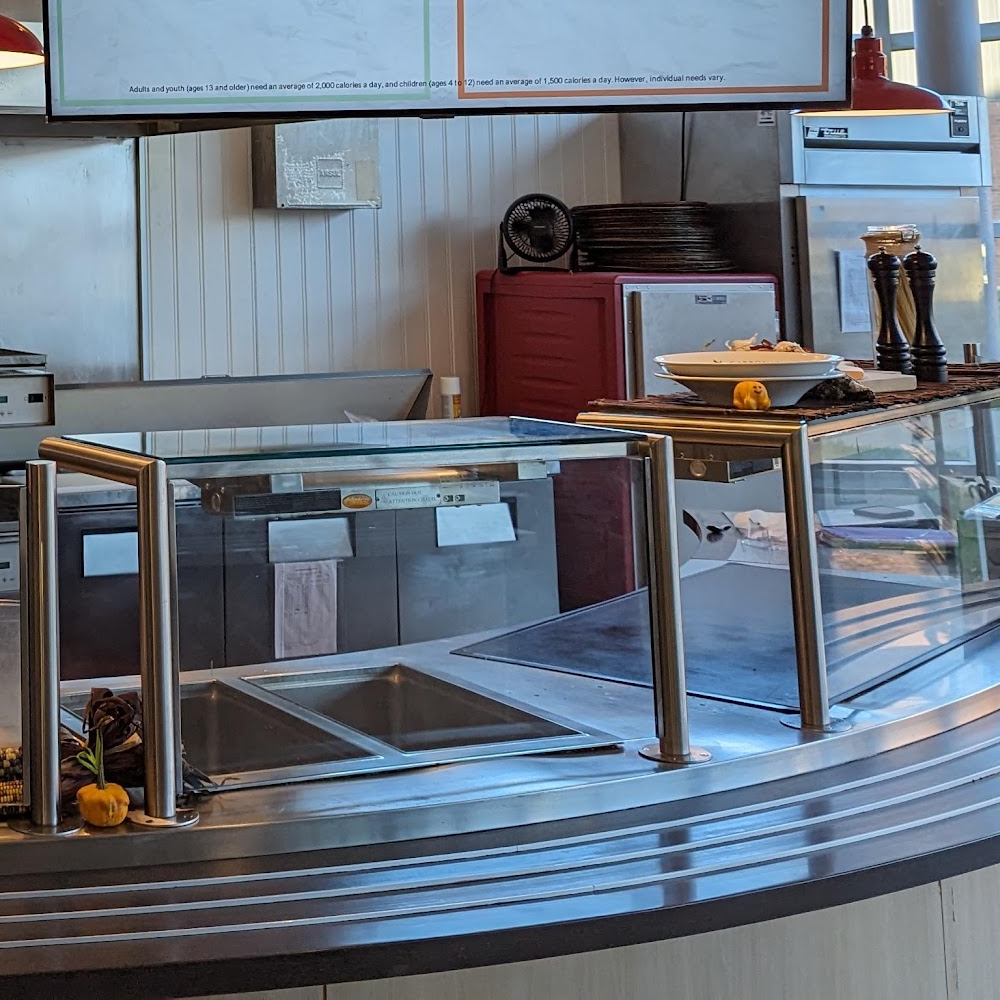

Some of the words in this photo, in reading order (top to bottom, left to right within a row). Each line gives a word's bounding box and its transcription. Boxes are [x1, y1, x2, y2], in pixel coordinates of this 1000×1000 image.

[166, 85, 185, 93] youth
[186, 84, 204, 93] (ages
[368, 81, 384, 89] day,
